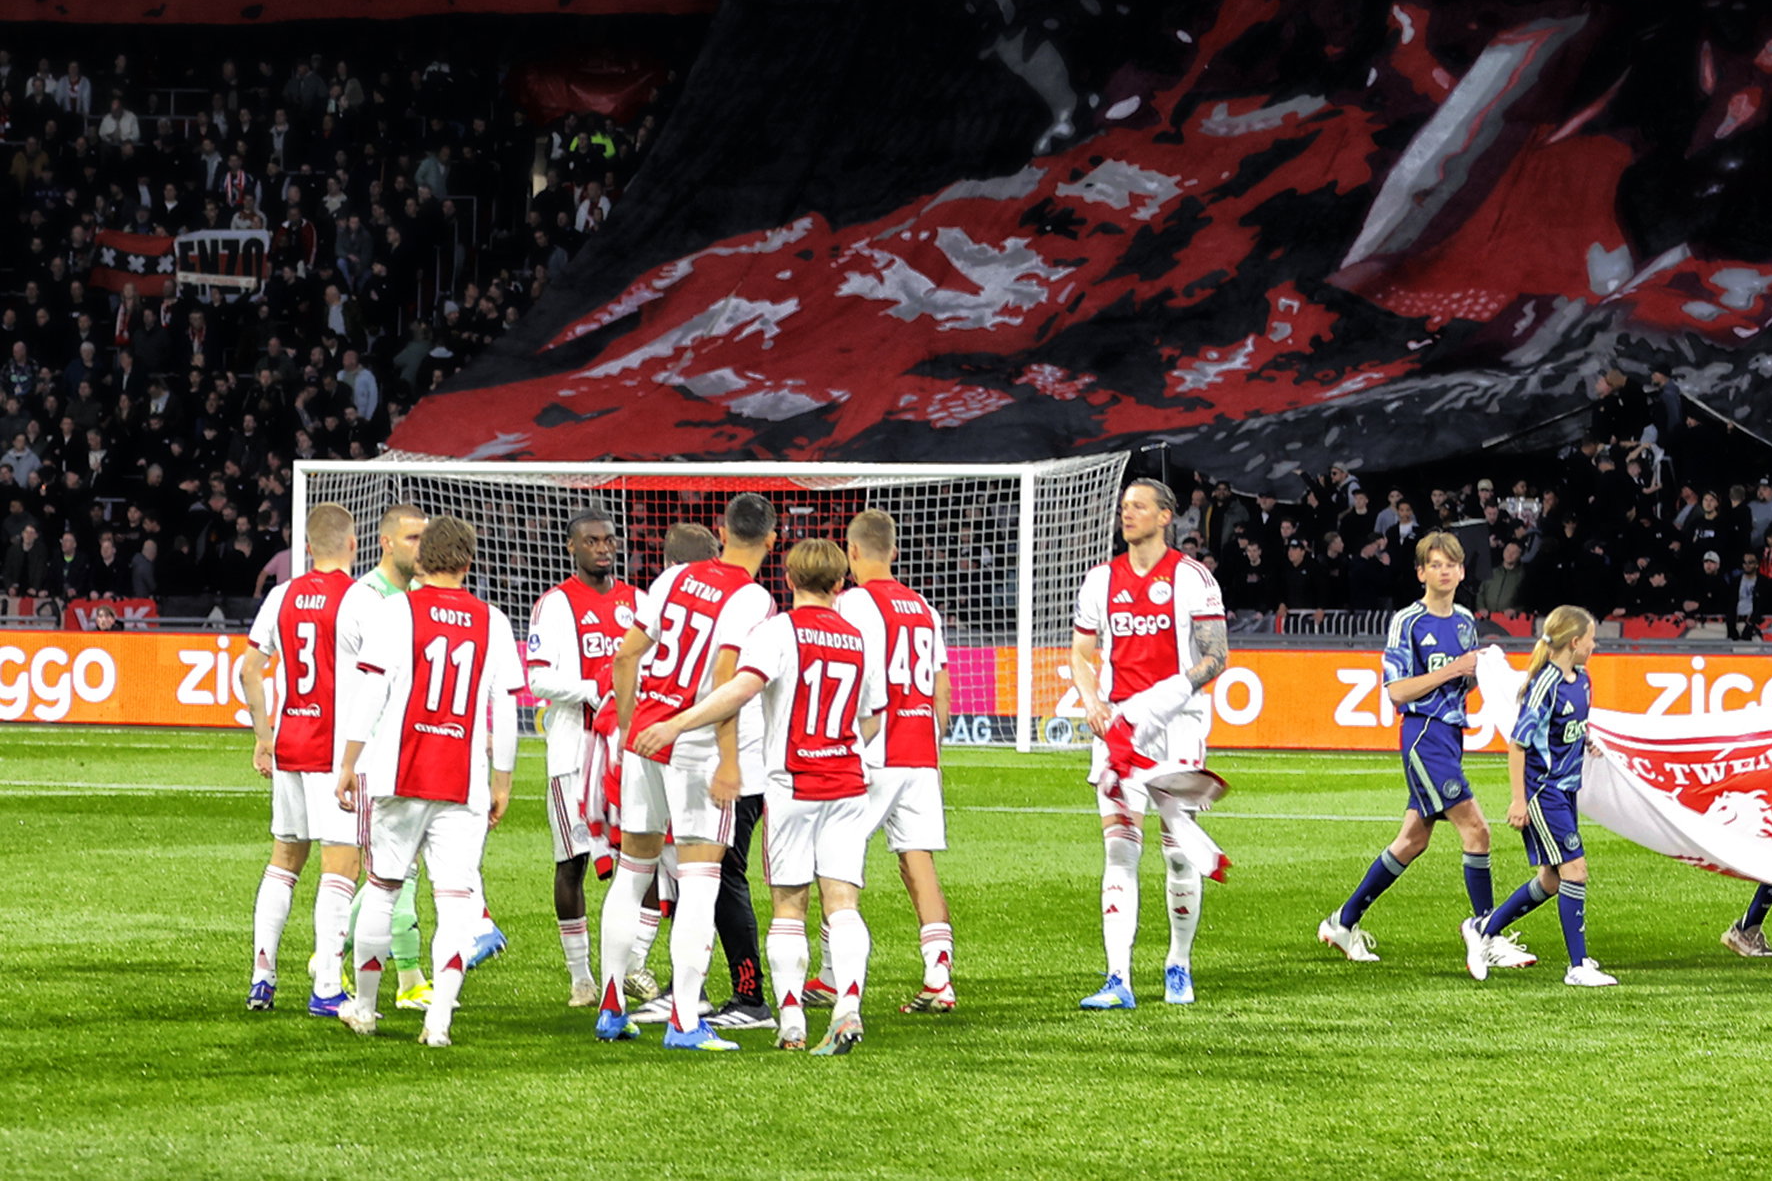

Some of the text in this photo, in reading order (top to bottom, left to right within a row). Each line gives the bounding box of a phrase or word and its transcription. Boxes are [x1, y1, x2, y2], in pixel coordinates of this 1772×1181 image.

[430, 606, 473, 627] GODTS
[651, 602, 715, 688] 37
[296, 622, 317, 695] 3
[424, 635, 477, 716] 11
[888, 625, 934, 697] 48
[802, 659, 858, 739] 17
